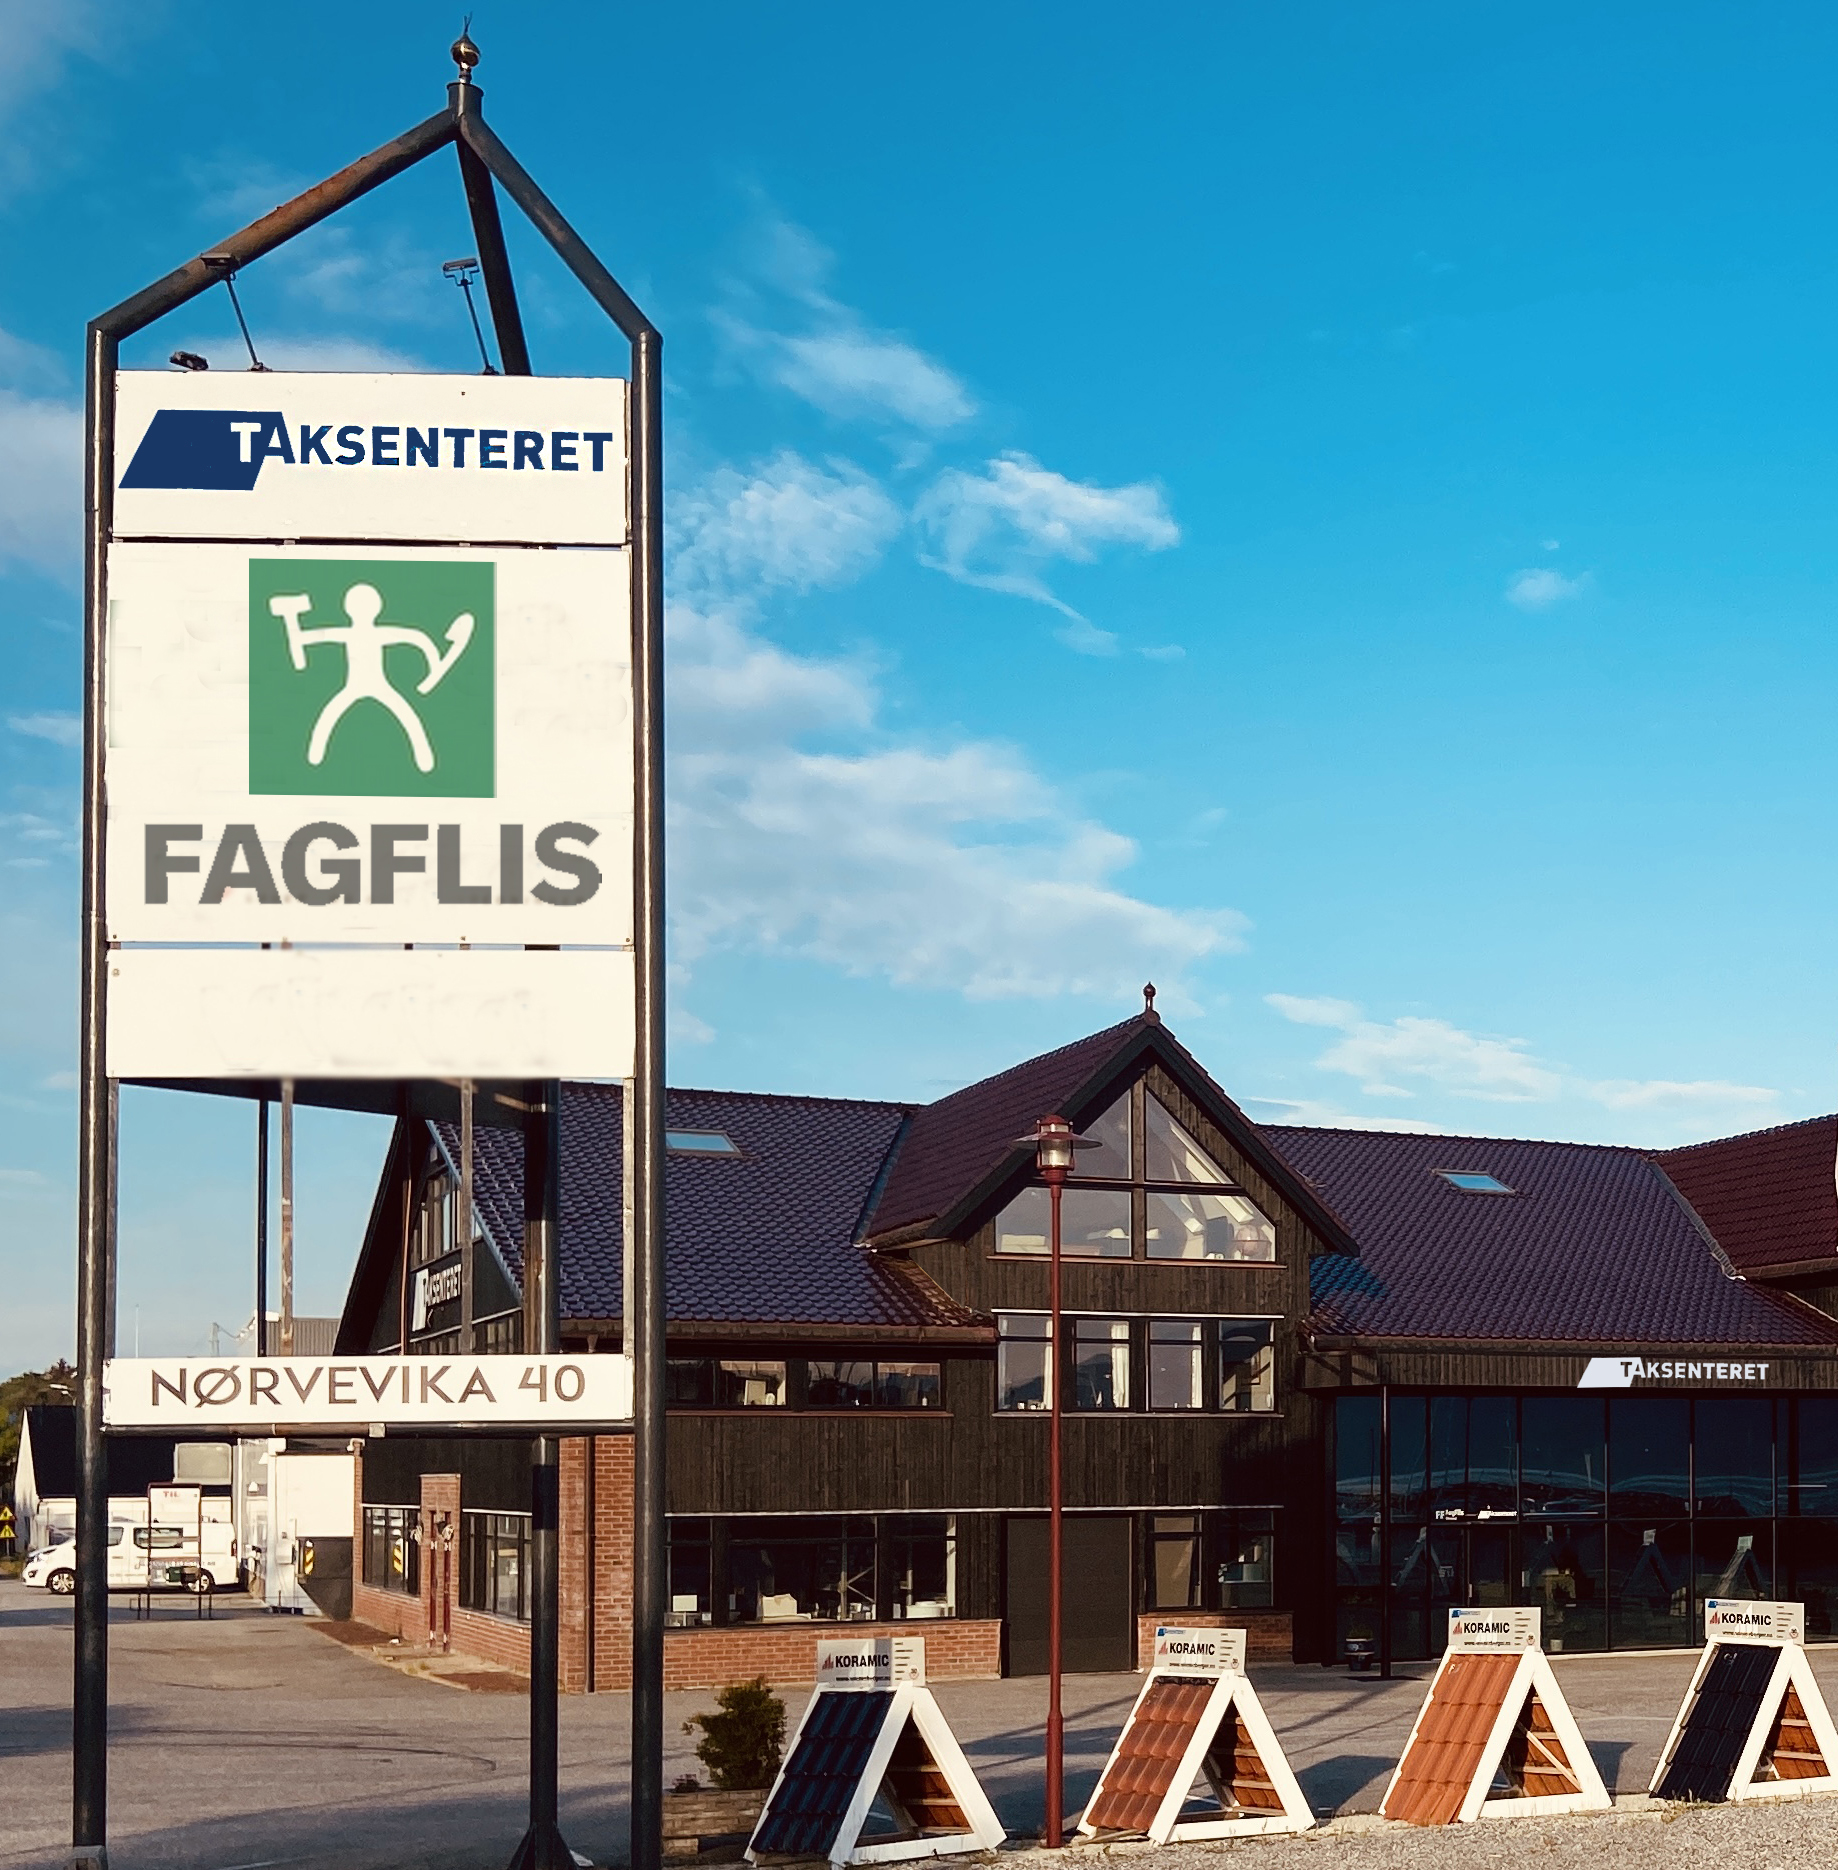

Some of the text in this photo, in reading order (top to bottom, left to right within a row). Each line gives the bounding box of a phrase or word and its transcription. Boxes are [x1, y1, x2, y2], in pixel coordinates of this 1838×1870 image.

[230, 421, 613, 472] TAKSENTERET
[144, 821, 602, 906] FAGFLIS
[1620, 1361, 1769, 1380] TAKSENTERET
[151, 1364, 586, 1408] NØRVEVIKA 40
[1464, 1622, 1510, 1633] KORAMIC
[1721, 1613, 1771, 1626] KORAMIC
[1170, 1643, 1215, 1655] KORAMIC
[836, 1654, 889, 1667] KORAMIC
